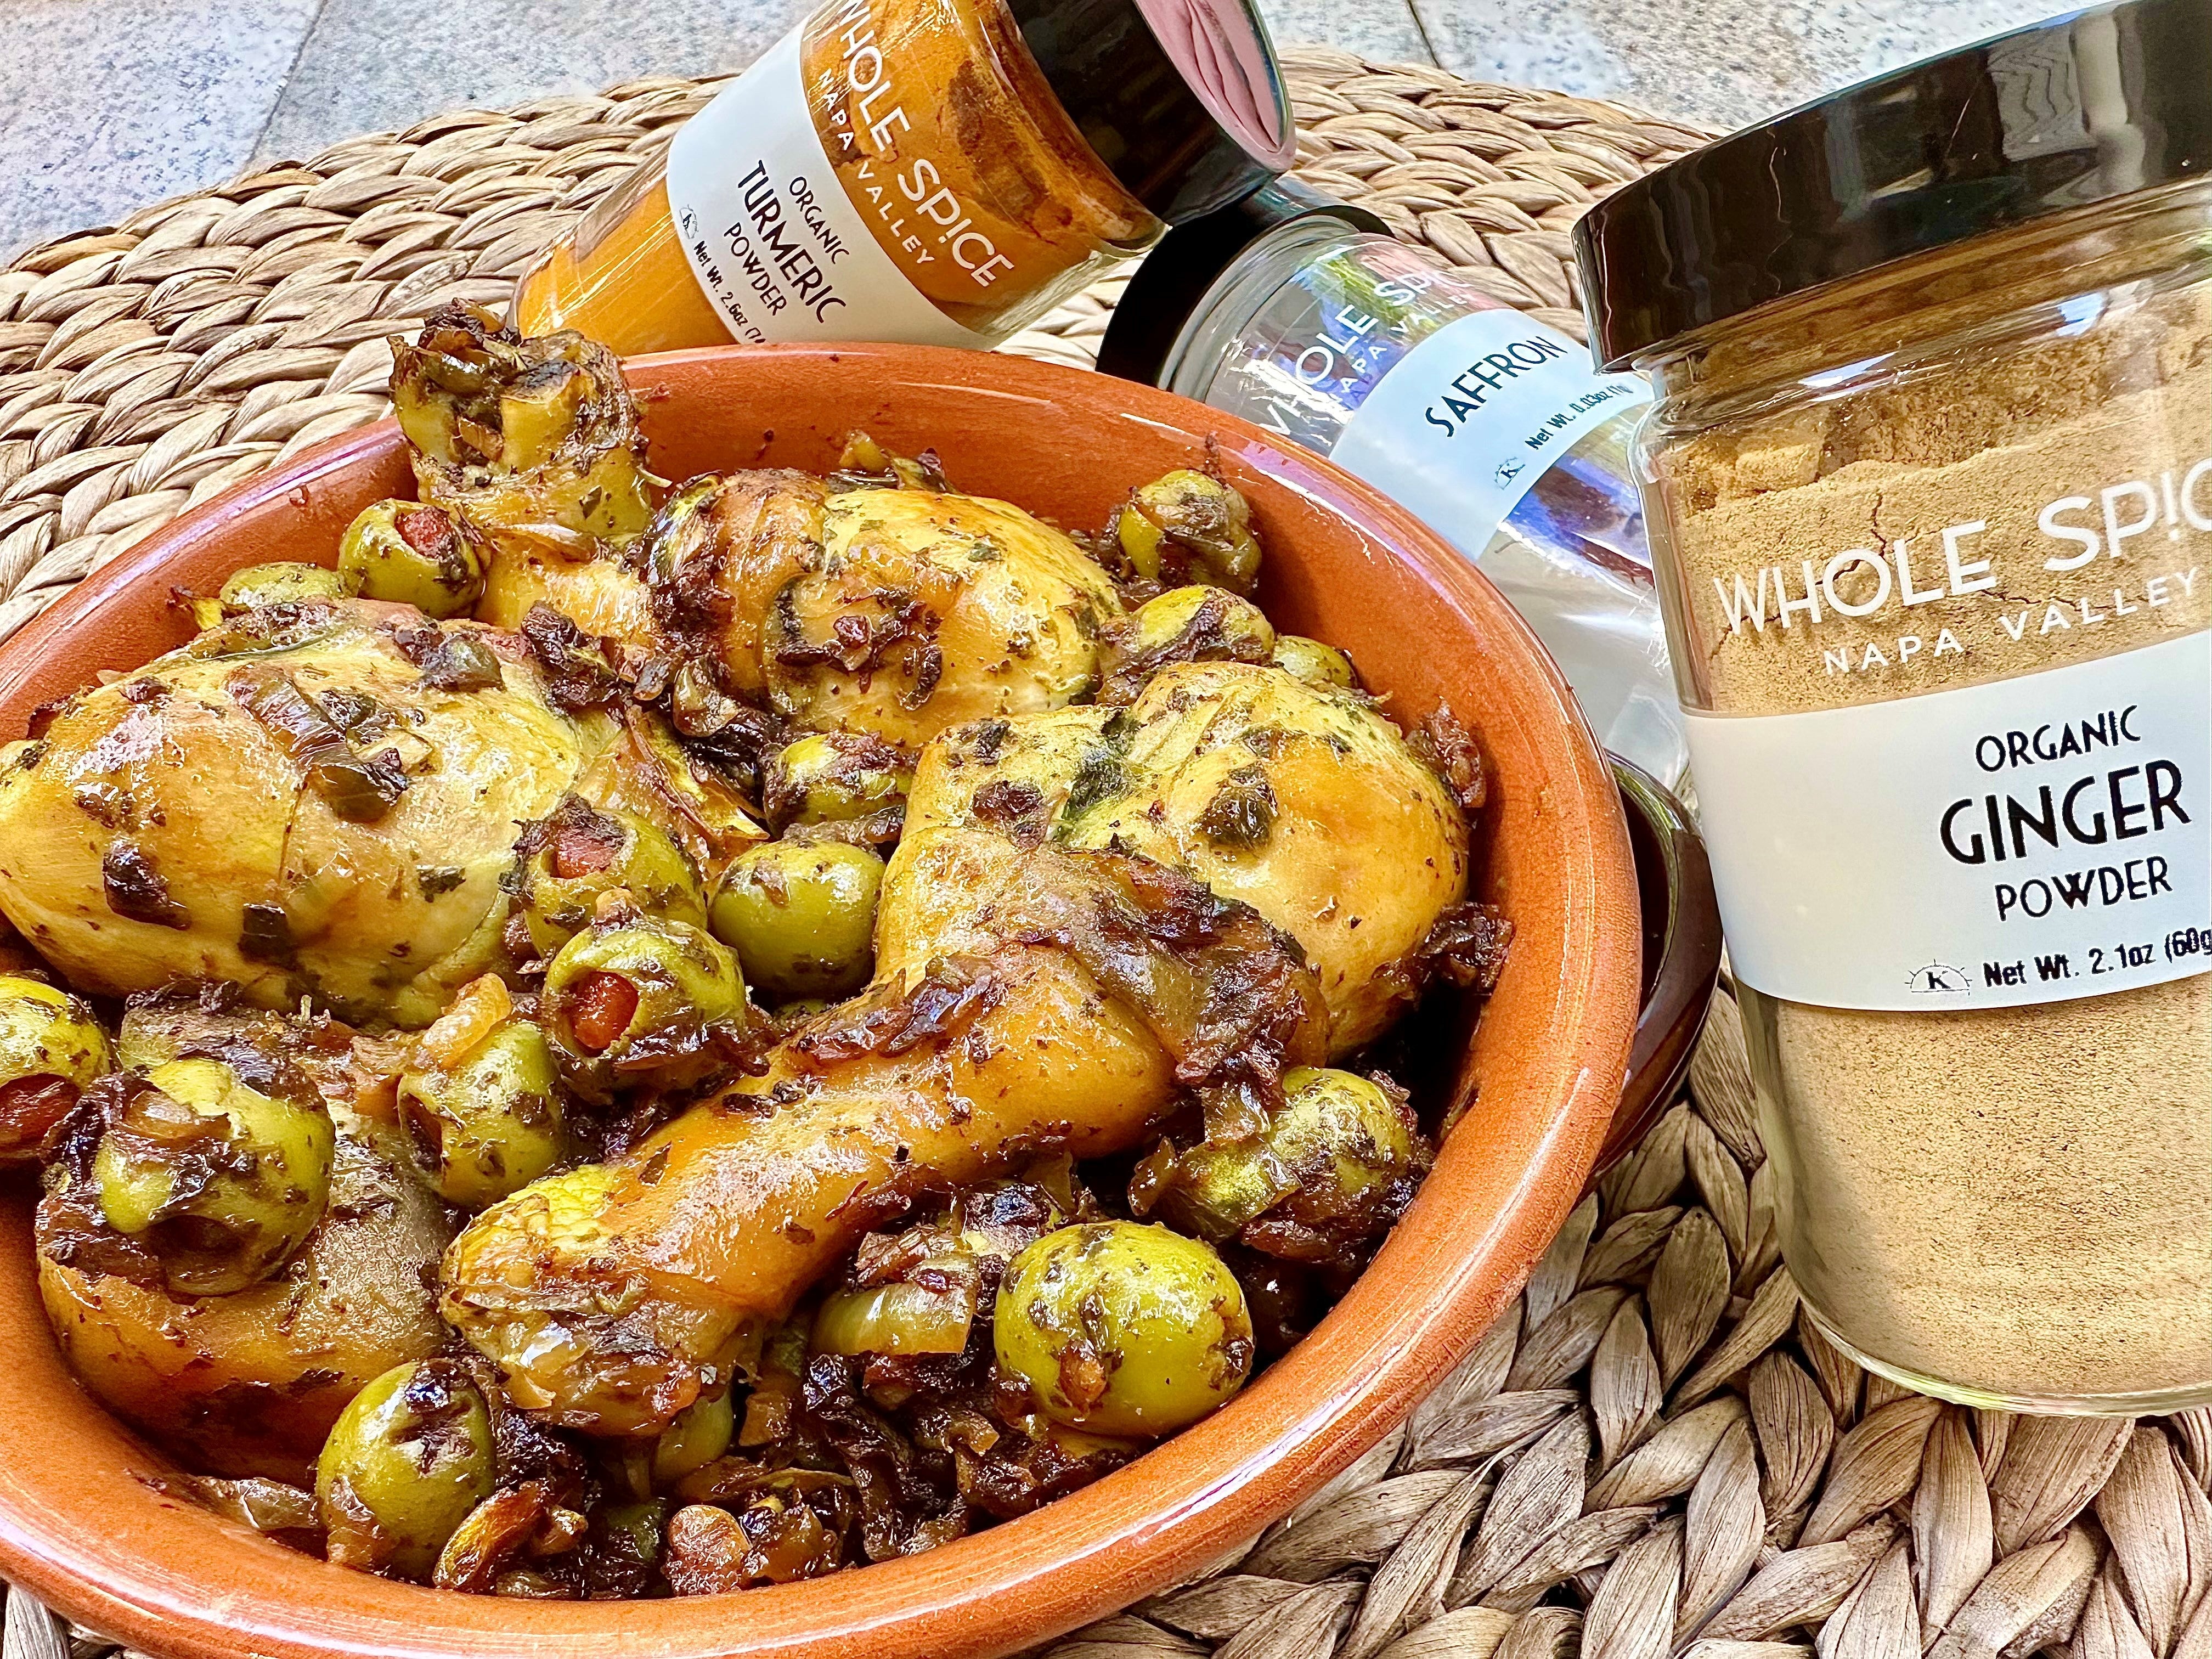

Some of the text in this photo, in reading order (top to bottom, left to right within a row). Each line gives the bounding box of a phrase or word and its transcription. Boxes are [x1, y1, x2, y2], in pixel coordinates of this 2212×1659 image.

[819, 68, 935, 264] NAPA VALLEY
[738, 160, 847, 323] TURMERIC
[789, 176, 849, 264] ORGANIC
[898, 159, 1014, 287] SPICE
[693, 240, 712, 267] Net
[707, 266, 724, 292] Wt.
[720, 291, 748, 326] 2.6oz
[724, 222, 787, 316] POWDER
[1329, 345, 1387, 402] APA
[1425, 335, 1568, 438] SAFFRON
[1525, 428, 1554, 450] Net
[1546, 413, 1576, 429] Wt.
[1713, 520, 1997, 635] WHOLE
[1823, 566, 2198, 676] NAPA VALLEY
[1975, 705, 2141, 772] ORGANIC
[1940, 759, 2192, 865] GINGER
[1995, 856, 2172, 921] POWDER
[1983, 961, 2027, 988] Net
[2034, 955, 2080, 981] Wt.
[2088, 944, 2157, 975] 2.1oz
